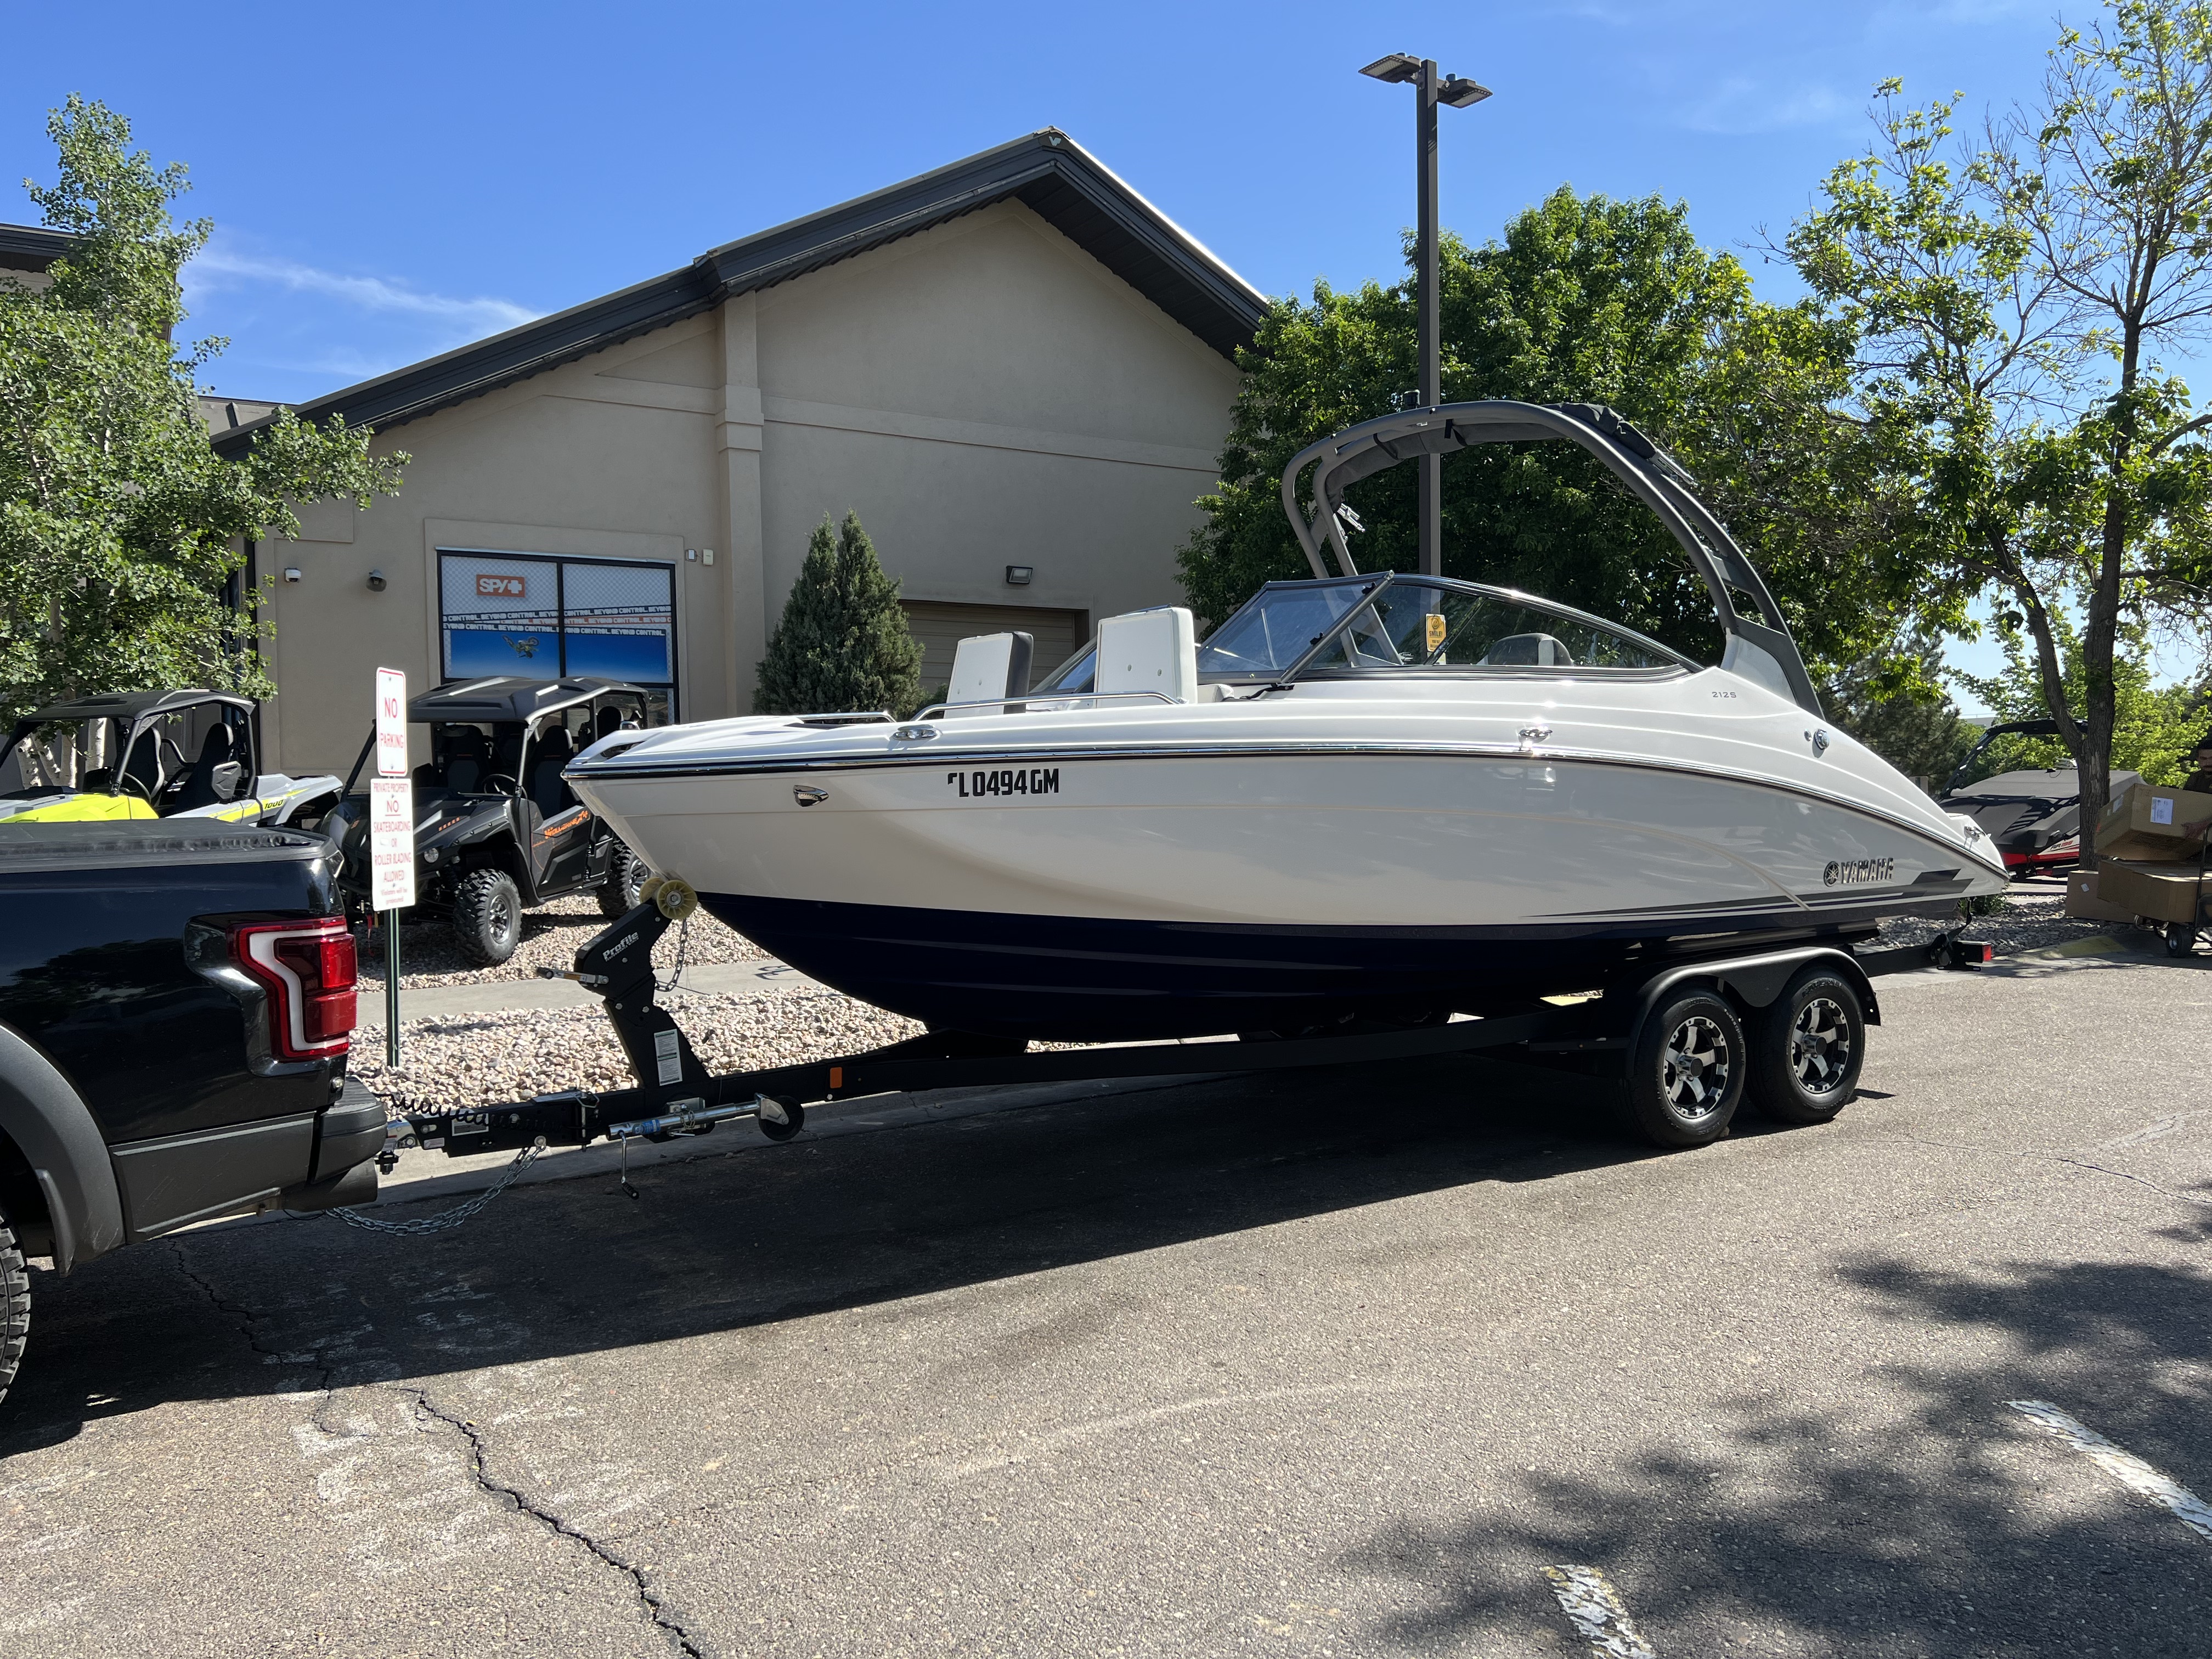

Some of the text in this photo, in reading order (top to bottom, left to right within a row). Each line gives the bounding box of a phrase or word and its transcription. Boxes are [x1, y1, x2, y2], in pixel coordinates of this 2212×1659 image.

[479, 578, 509, 593] SPY
[385, 697, 398, 719] NO
[380, 732, 404, 749] PARKING
[374, 783, 409, 793] PRIVATE PROPERTY
[264, 799, 284, 810] 1000
[387, 800, 399, 813] NO
[374, 821, 411, 833] SKATEBOARDING
[391, 838, 398, 848] OR
[374, 852, 411, 866] ROLLER BLADING
[384, 870, 404, 883] ALLOWED
[1841, 857, 1894, 884] YAMAHA
[602, 932, 639, 960] Profile
